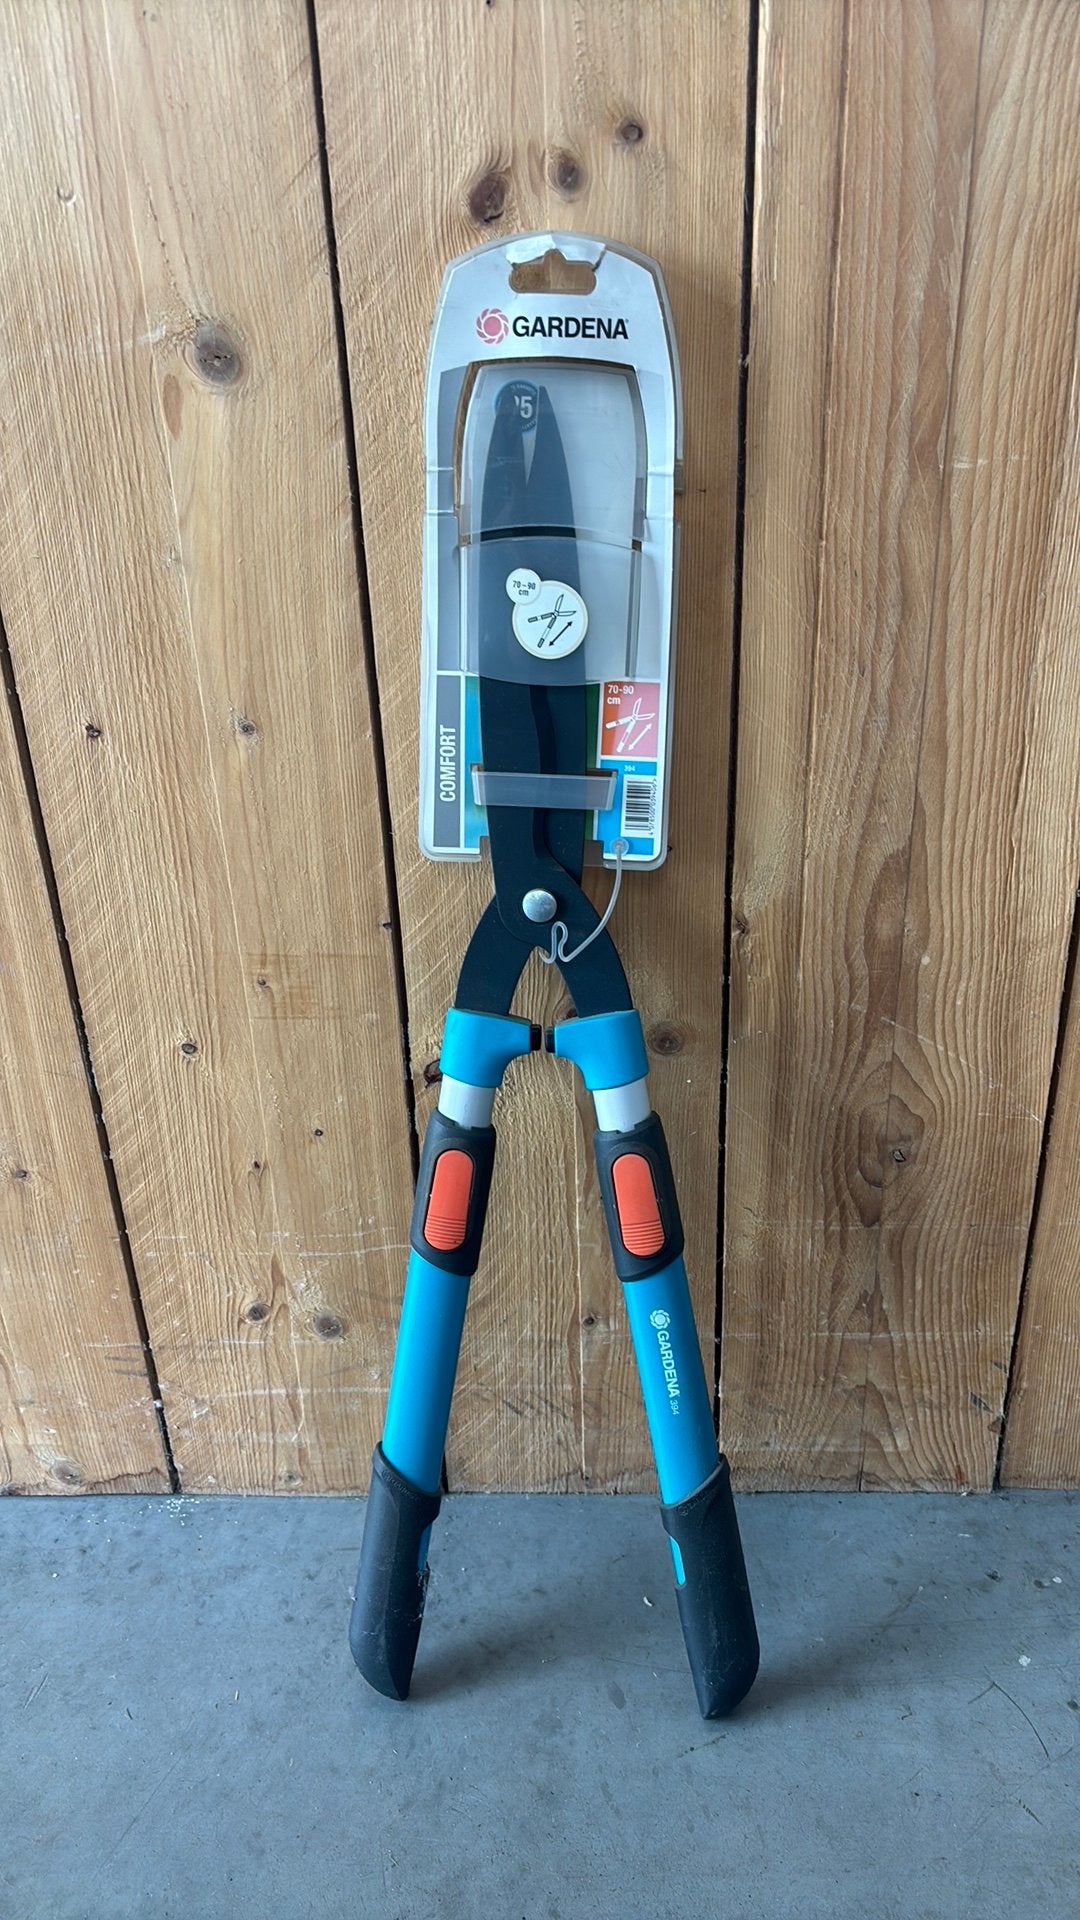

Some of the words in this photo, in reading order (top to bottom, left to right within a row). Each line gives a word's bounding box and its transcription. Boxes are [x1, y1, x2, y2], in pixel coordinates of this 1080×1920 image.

[512, 316, 629, 340] GARDENA
[607, 684, 634, 695] 70-90
[607, 697, 621, 705] cm
[439, 724, 456, 802] COMFORT
[657, 1330, 680, 1398] GARDENA
[670, 1399, 680, 1415] 394
